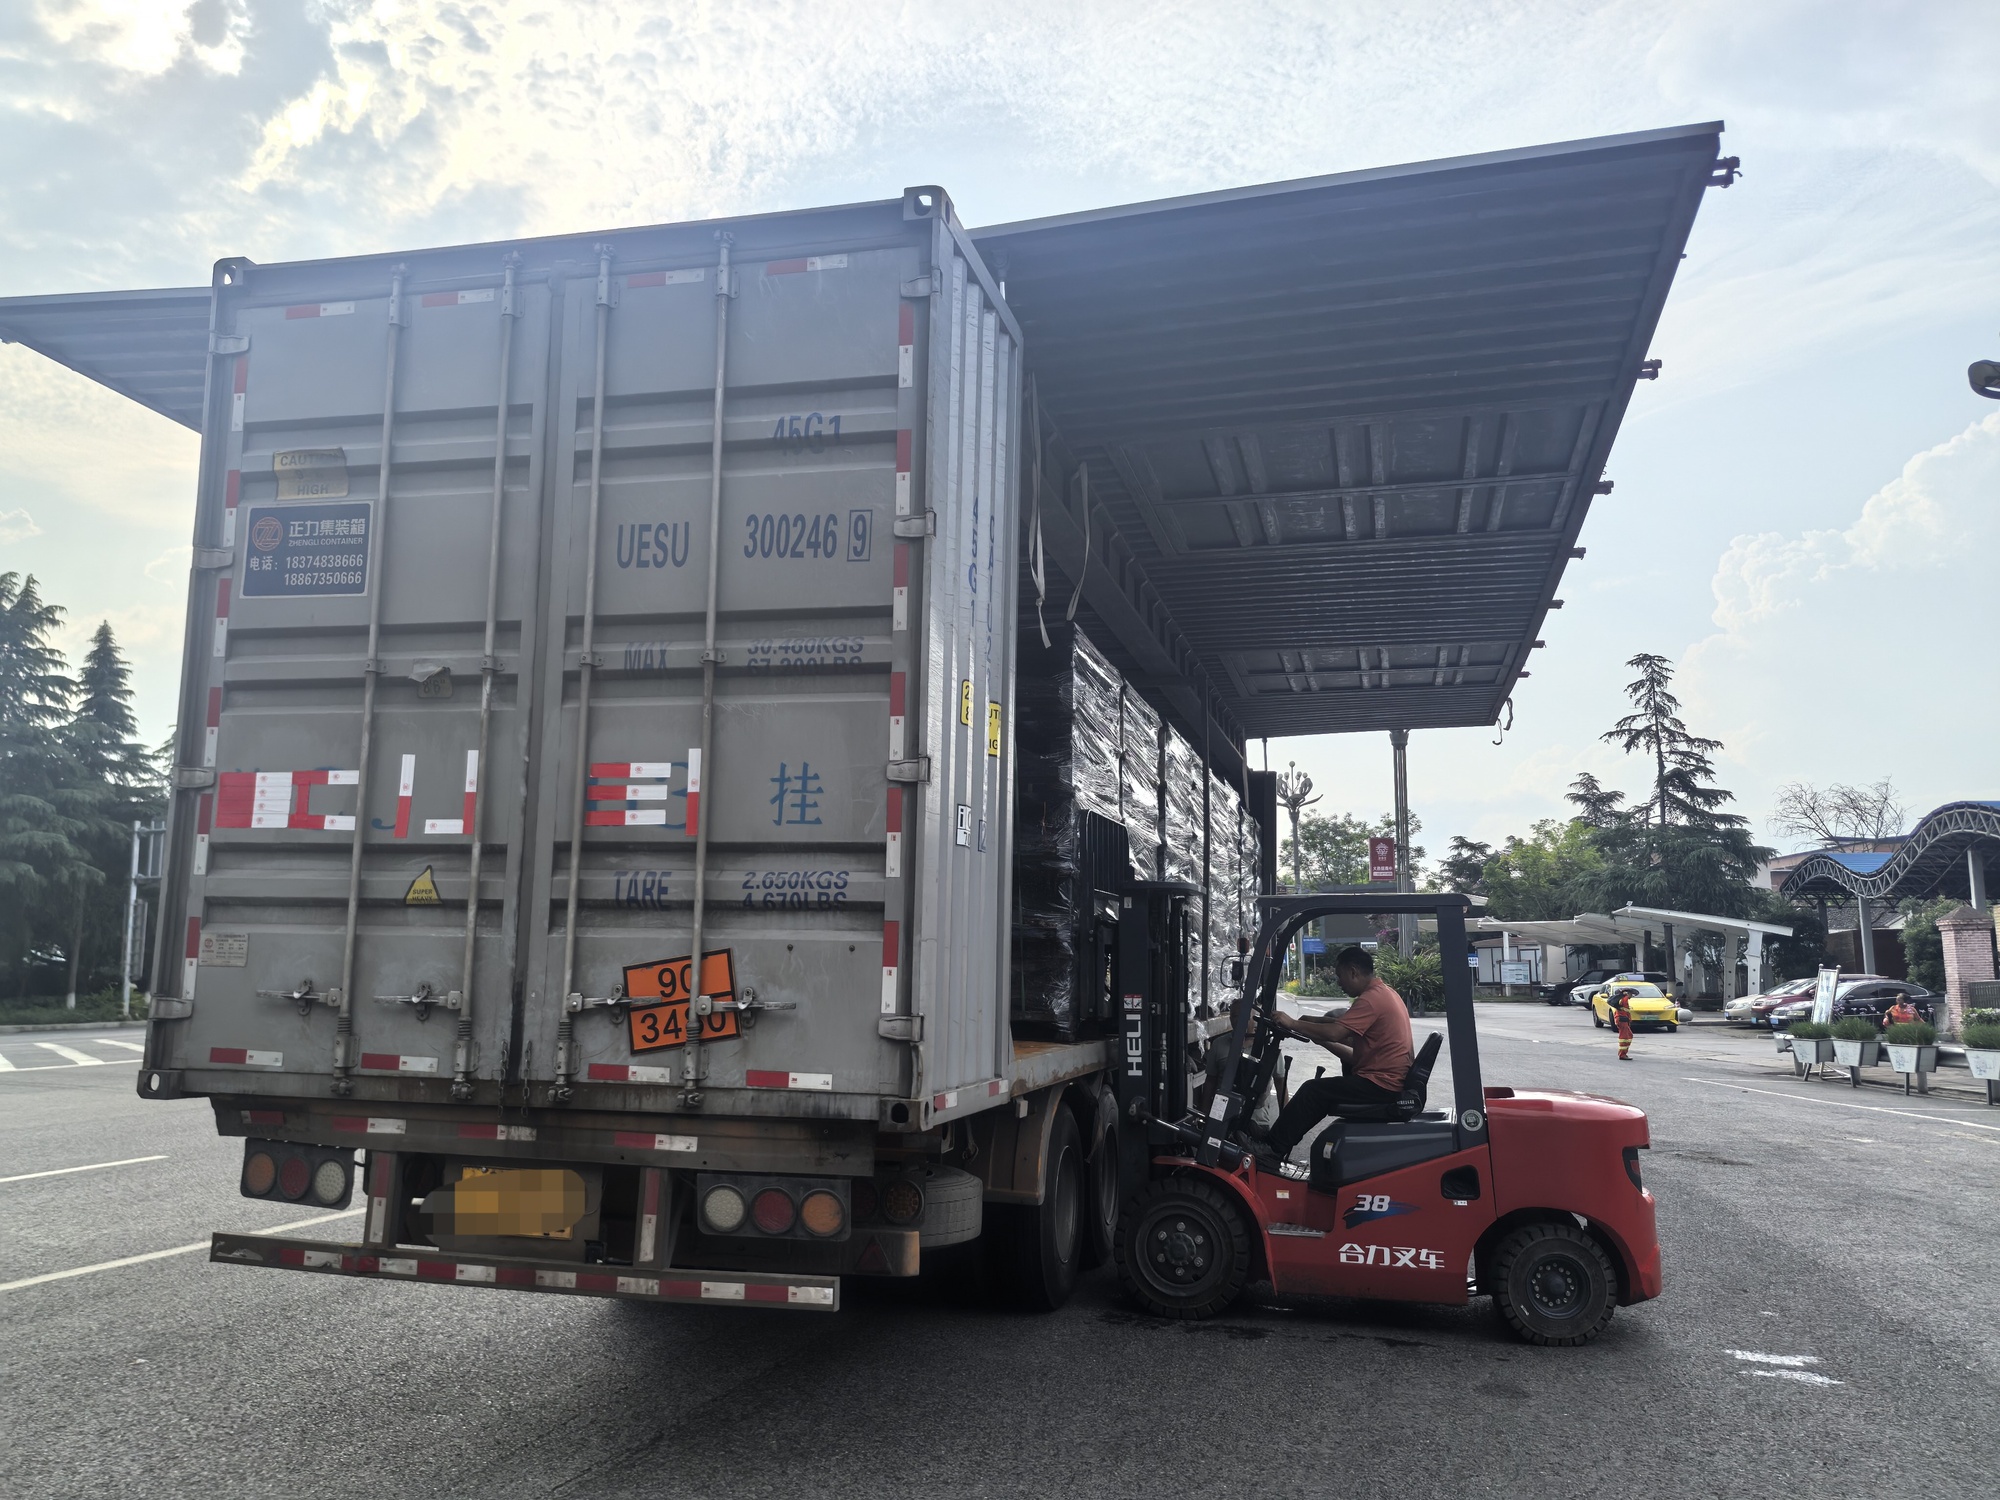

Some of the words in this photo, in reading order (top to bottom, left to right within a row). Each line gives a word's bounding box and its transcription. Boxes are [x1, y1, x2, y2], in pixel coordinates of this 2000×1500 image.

[774, 412, 841, 456] 45G1
[297, 484, 329, 496] HIGH
[288, 518, 366, 538] 正力集装箱
[288, 539, 320, 547] ZHENGLI
[320, 537, 363, 546] CONTAINER
[617, 521, 690, 569] UESU
[744, 513, 838, 559] 300246
[851, 513, 868, 558] 9
[286, 554, 364, 569] 18374838666
[284, 571, 362, 586] 18867350666
[624, 641, 672, 672] MAX
[770, 761, 824, 826] 挂
[613, 871, 672, 912] TARE
[742, 870, 849, 890] 2.650KGS
[743, 891, 847, 911] 4670LBS
[1126, 1014, 1143, 1076] HELI
[1353, 1194, 1391, 1212] 38
[1339, 1243, 1445, 1269] 合力叉车
